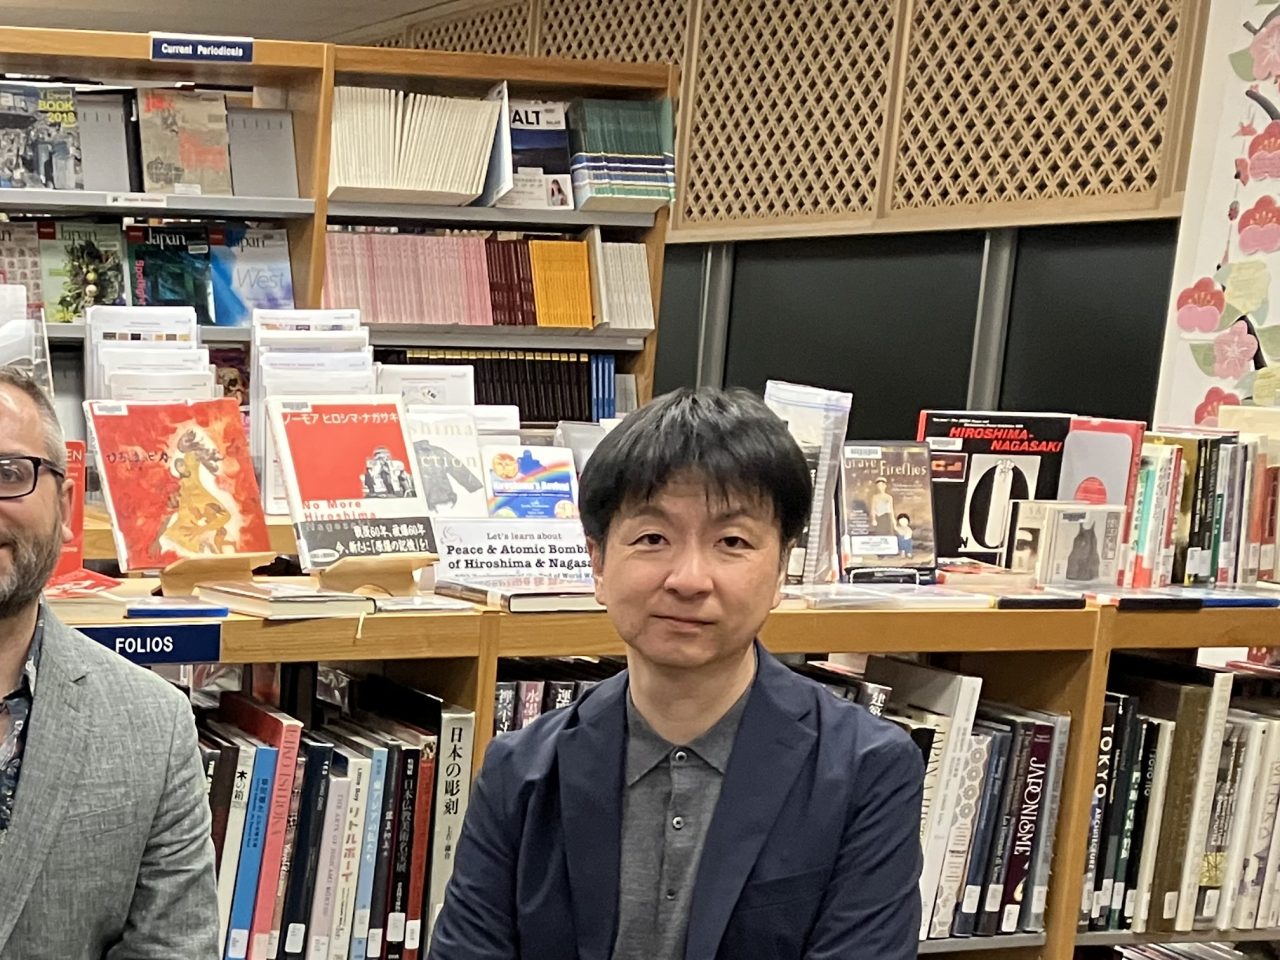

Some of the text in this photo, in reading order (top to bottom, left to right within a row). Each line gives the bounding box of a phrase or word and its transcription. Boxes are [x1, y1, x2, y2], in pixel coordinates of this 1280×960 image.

[161, 43, 243, 57] Current Periodicals
[38, 100, 74, 111] BOOK
[145, 227, 186, 250] Japan
[236, 267, 284, 290] West
[284, 413, 399, 425] ノーモア ヒロシマ・ナガサキ
[949, 427, 1035, 439] HIROSHIMA-
[990, 440, 1063, 452] NAGASAKI
[879, 460, 927, 476] Fireflies
[303, 500, 361, 510] No More
[304, 511, 377, 522] Hiroshima
[487, 532, 509, 540] Let's
[537, 532, 562, 540] about
[447, 545, 589, 555] Peace & Atomic Bombi
[448, 558, 593, 570] of Hiroshima & Nagasa
[115, 636, 174, 653] FOLIOS
[282, 729, 298, 768] EIKO
[443, 727, 464, 816] 日本の彫刻
[1088, 724, 1115, 869] TOKYO ARCHITECTURE
[1261, 761, 1280, 839] MINKA
[1014, 757, 1046, 856] JAPONISME
[341, 806, 360, 883] リトルボーイ
